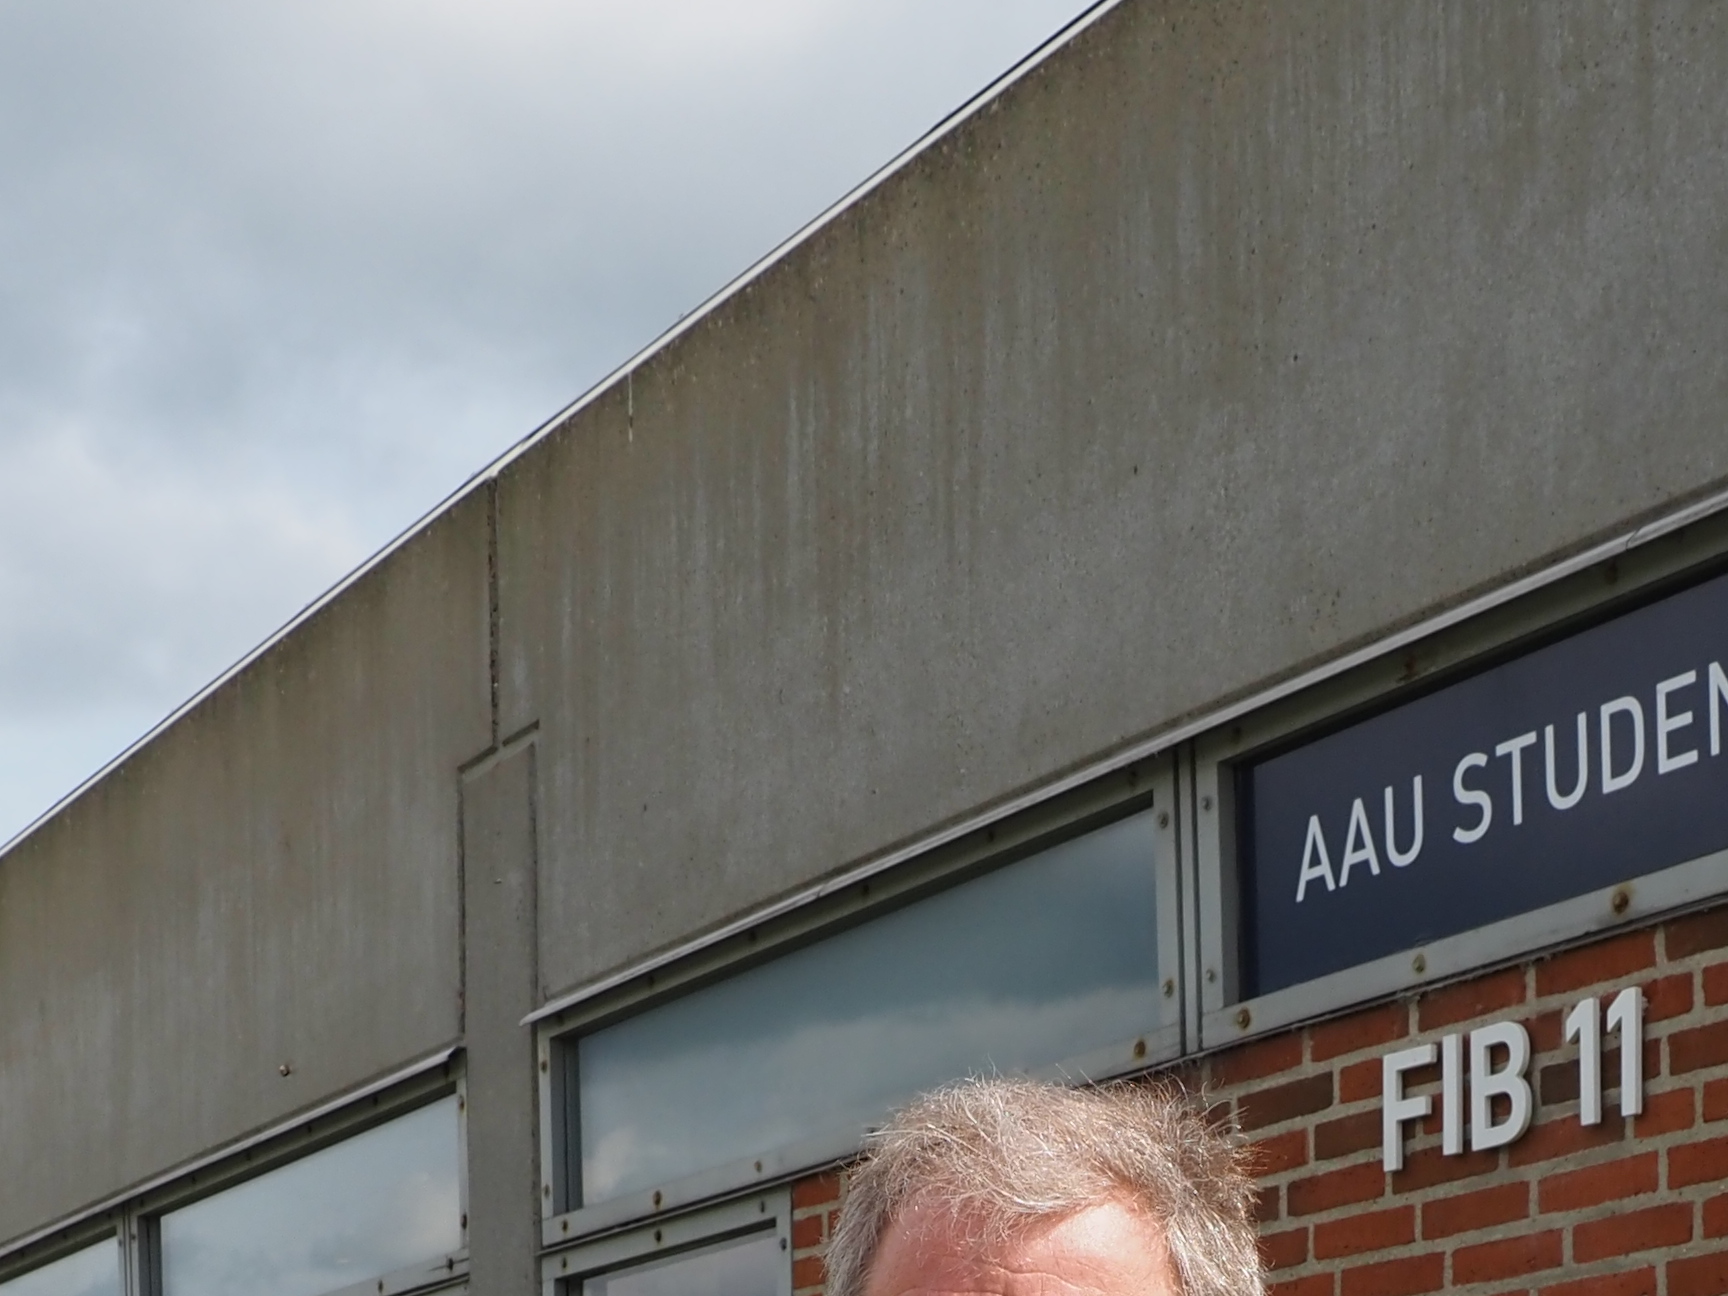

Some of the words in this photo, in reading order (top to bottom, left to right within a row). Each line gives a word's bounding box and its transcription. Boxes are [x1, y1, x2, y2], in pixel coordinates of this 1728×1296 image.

[1296, 774, 1423, 903] AAU
[1383, 1020, 1533, 1172] FIB
[1565, 986, 1643, 1126] 11
